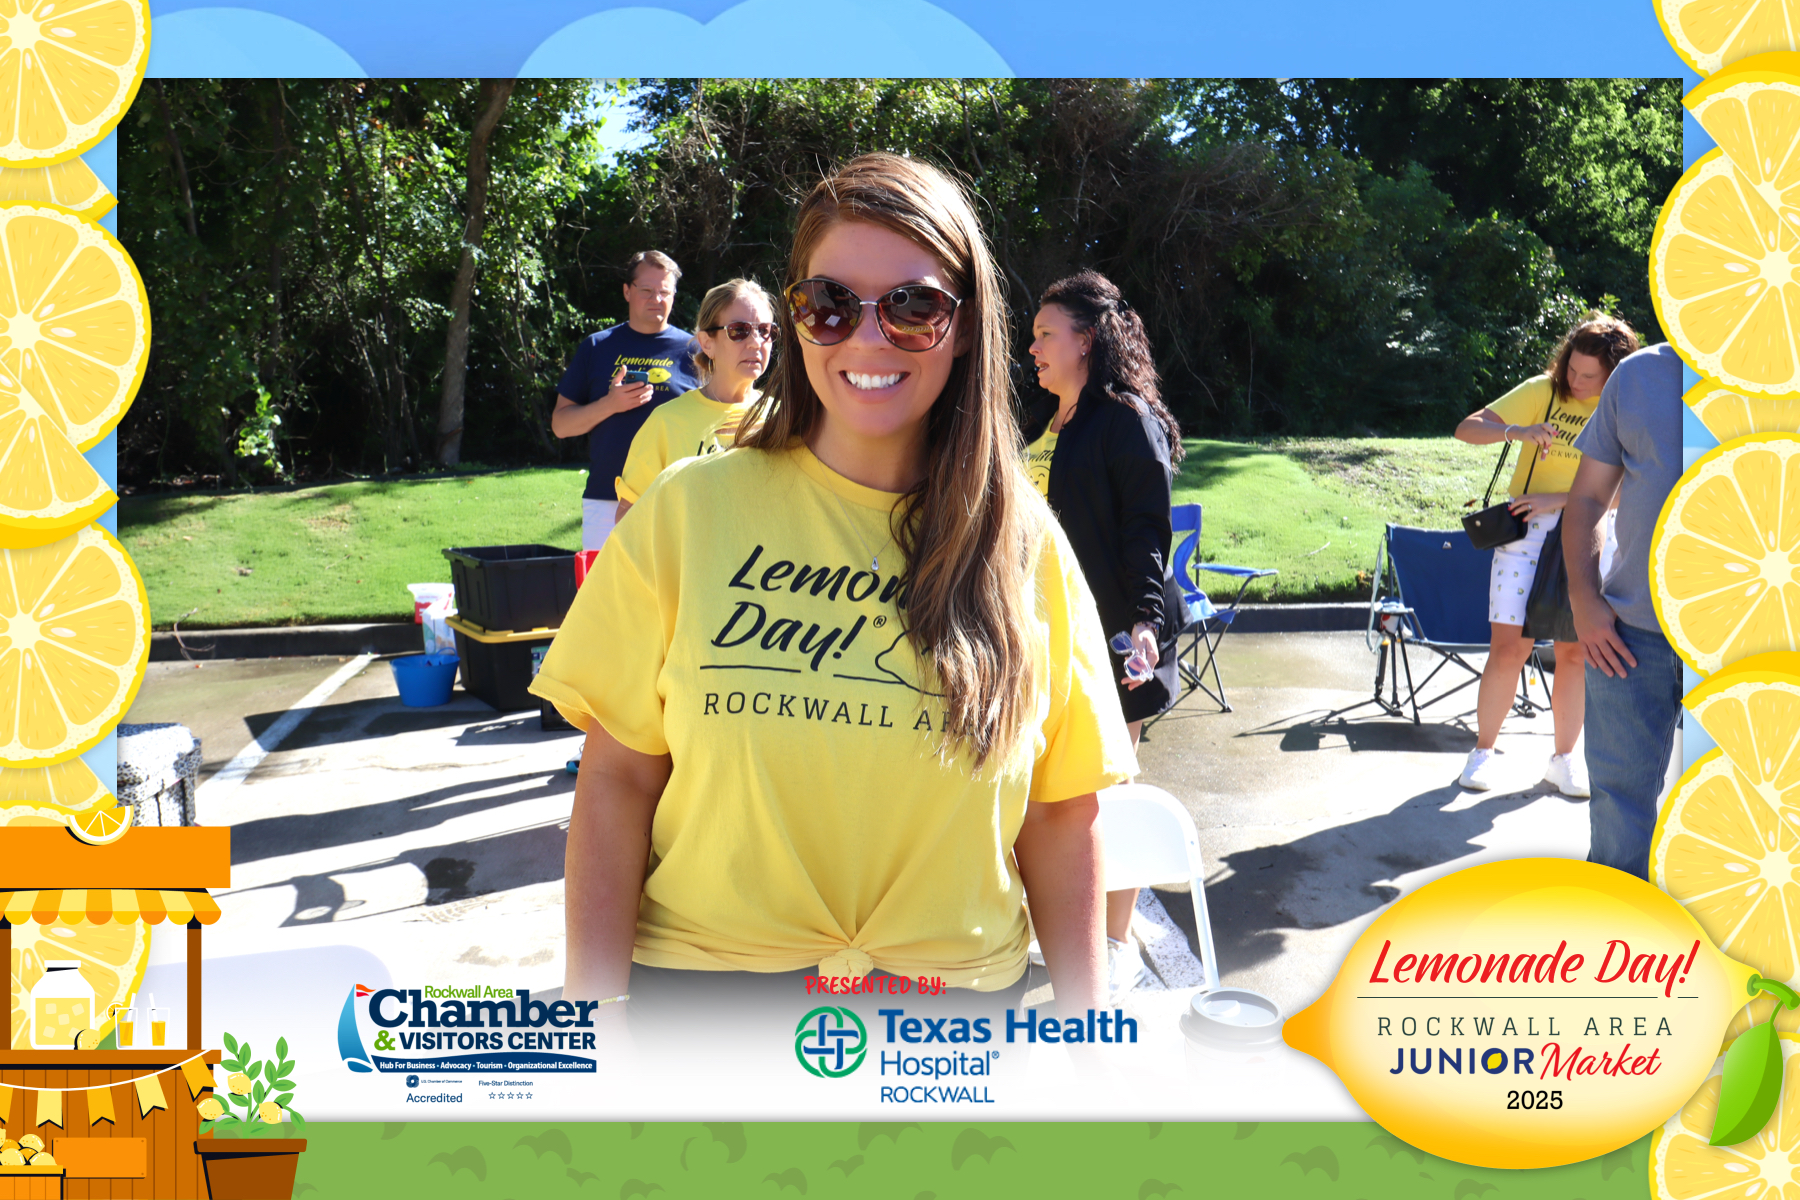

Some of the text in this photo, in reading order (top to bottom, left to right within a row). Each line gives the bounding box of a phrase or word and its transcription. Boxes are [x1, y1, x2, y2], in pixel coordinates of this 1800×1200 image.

[614, 354, 674, 367] Lemonade
[1550, 406, 1590, 427] Lemo
[728, 544, 912, 609] Lemon
[703, 691, 894, 728] ROCKWALL
